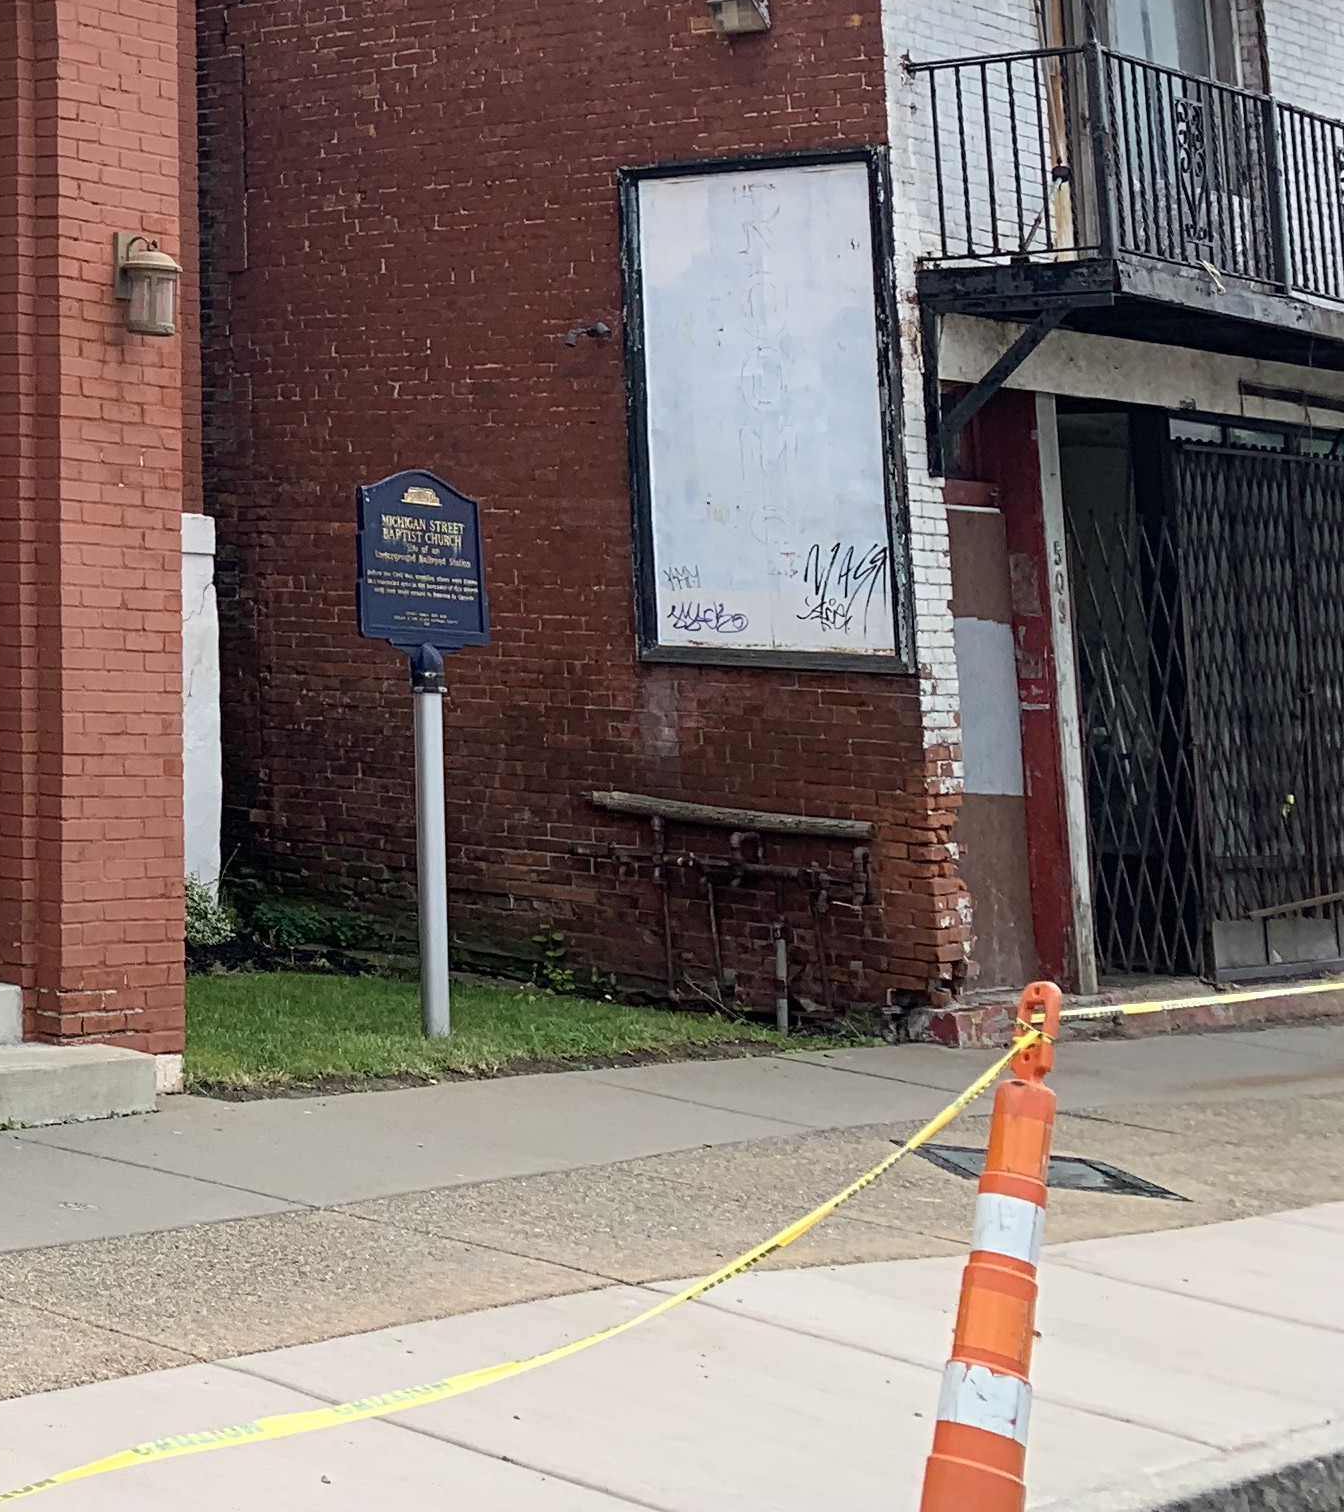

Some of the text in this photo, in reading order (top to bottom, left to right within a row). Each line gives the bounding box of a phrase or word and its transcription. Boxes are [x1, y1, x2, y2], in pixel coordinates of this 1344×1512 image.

[381, 514, 465, 534] MICHIGAN STREET
[382, 527, 462, 548] BAPTIST CHURCH
